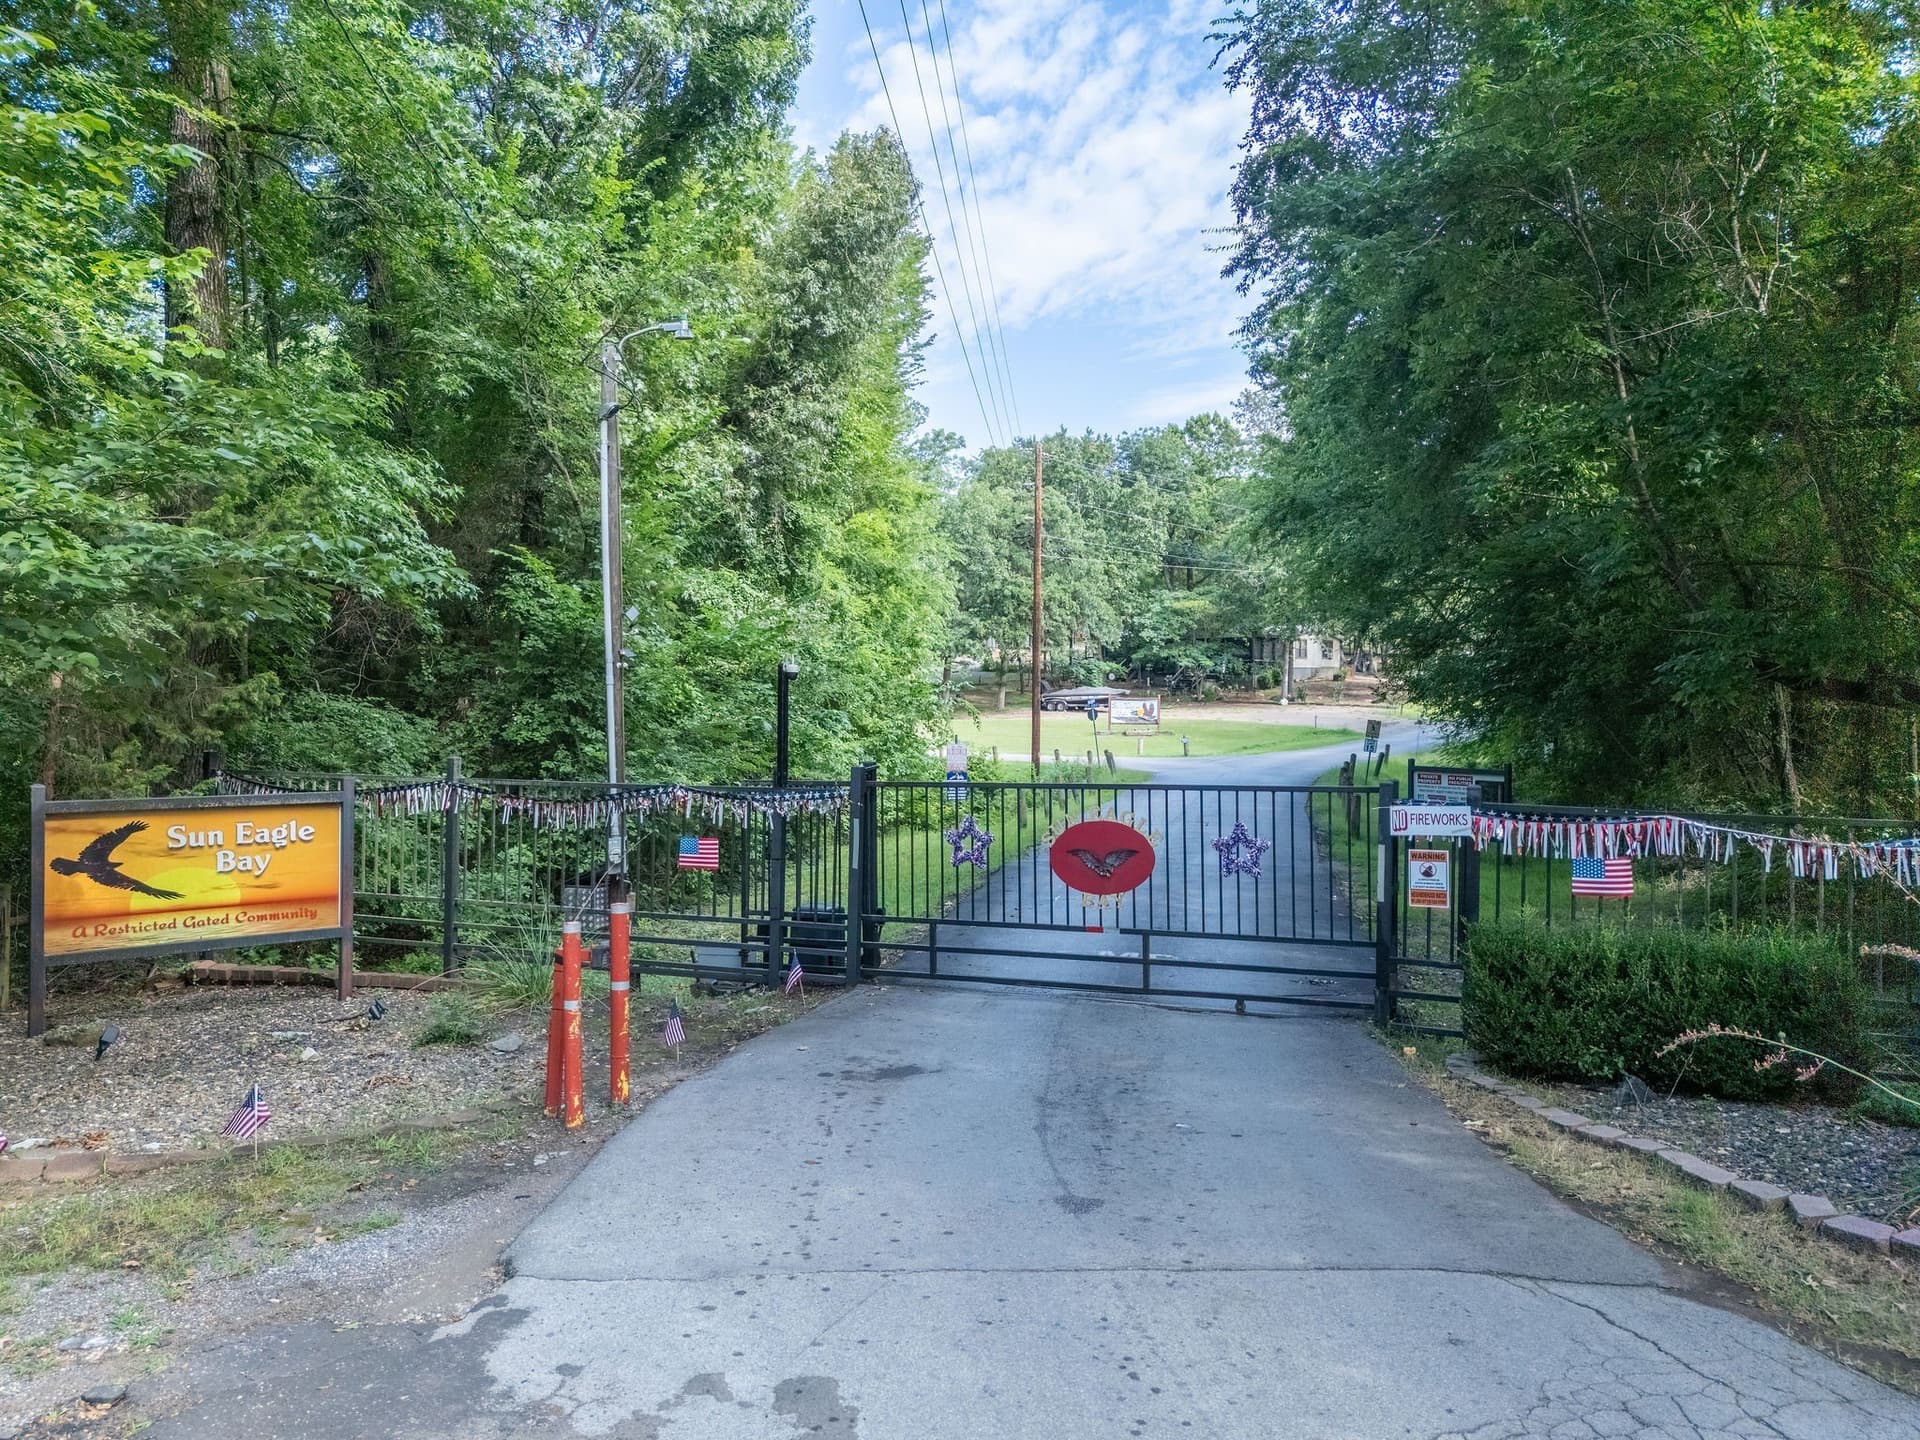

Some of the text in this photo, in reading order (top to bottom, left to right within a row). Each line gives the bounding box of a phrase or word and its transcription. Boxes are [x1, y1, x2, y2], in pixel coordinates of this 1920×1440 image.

[167, 819, 316, 849] Sun Eagle
[1392, 809, 1468, 832] NO FIREWORKS
[215, 849, 271, 876] Bay
[1411, 852, 1445, 860] WARNING
[72, 907, 318, 939] A Restricted Gated Community
